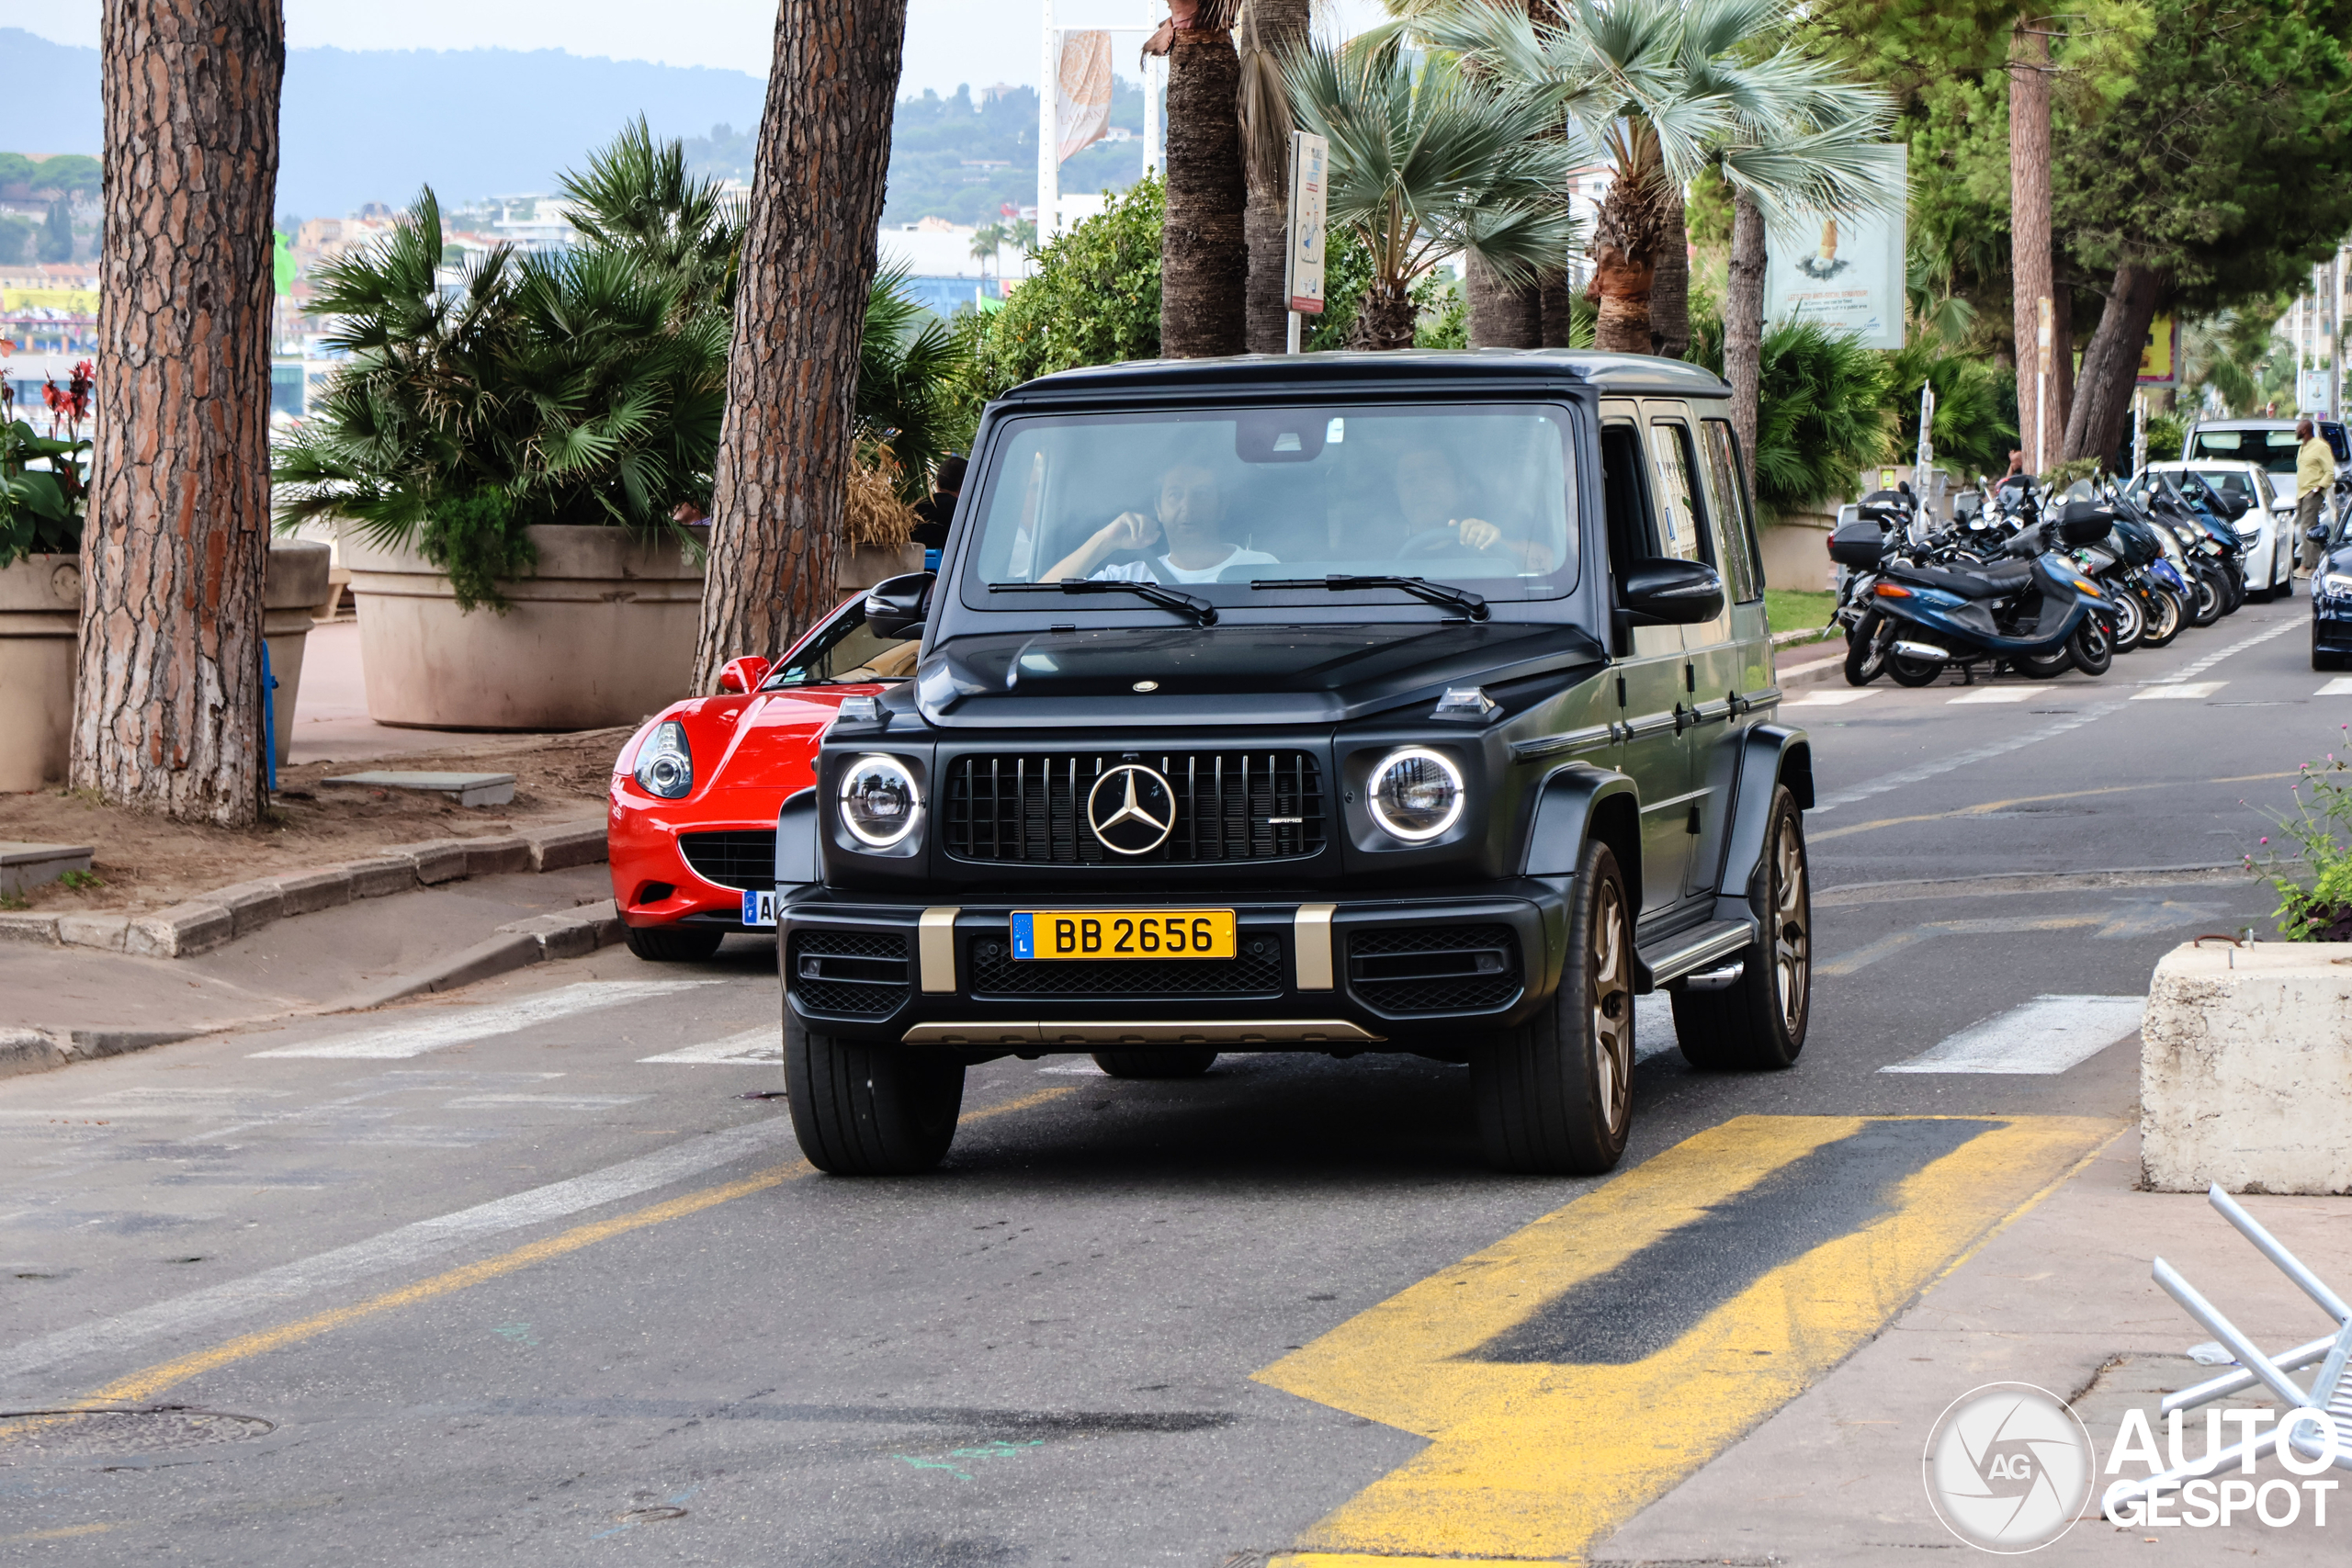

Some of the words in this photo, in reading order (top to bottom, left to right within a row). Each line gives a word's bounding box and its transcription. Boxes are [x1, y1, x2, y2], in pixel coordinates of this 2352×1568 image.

[1813, 291, 1840, 299] ANTI-SOCIAL
[761, 896, 777, 920] A
[1056, 919, 1102, 953] BB
[1114, 918, 1213, 953] 2656
[1019, 940, 1027, 952] L
